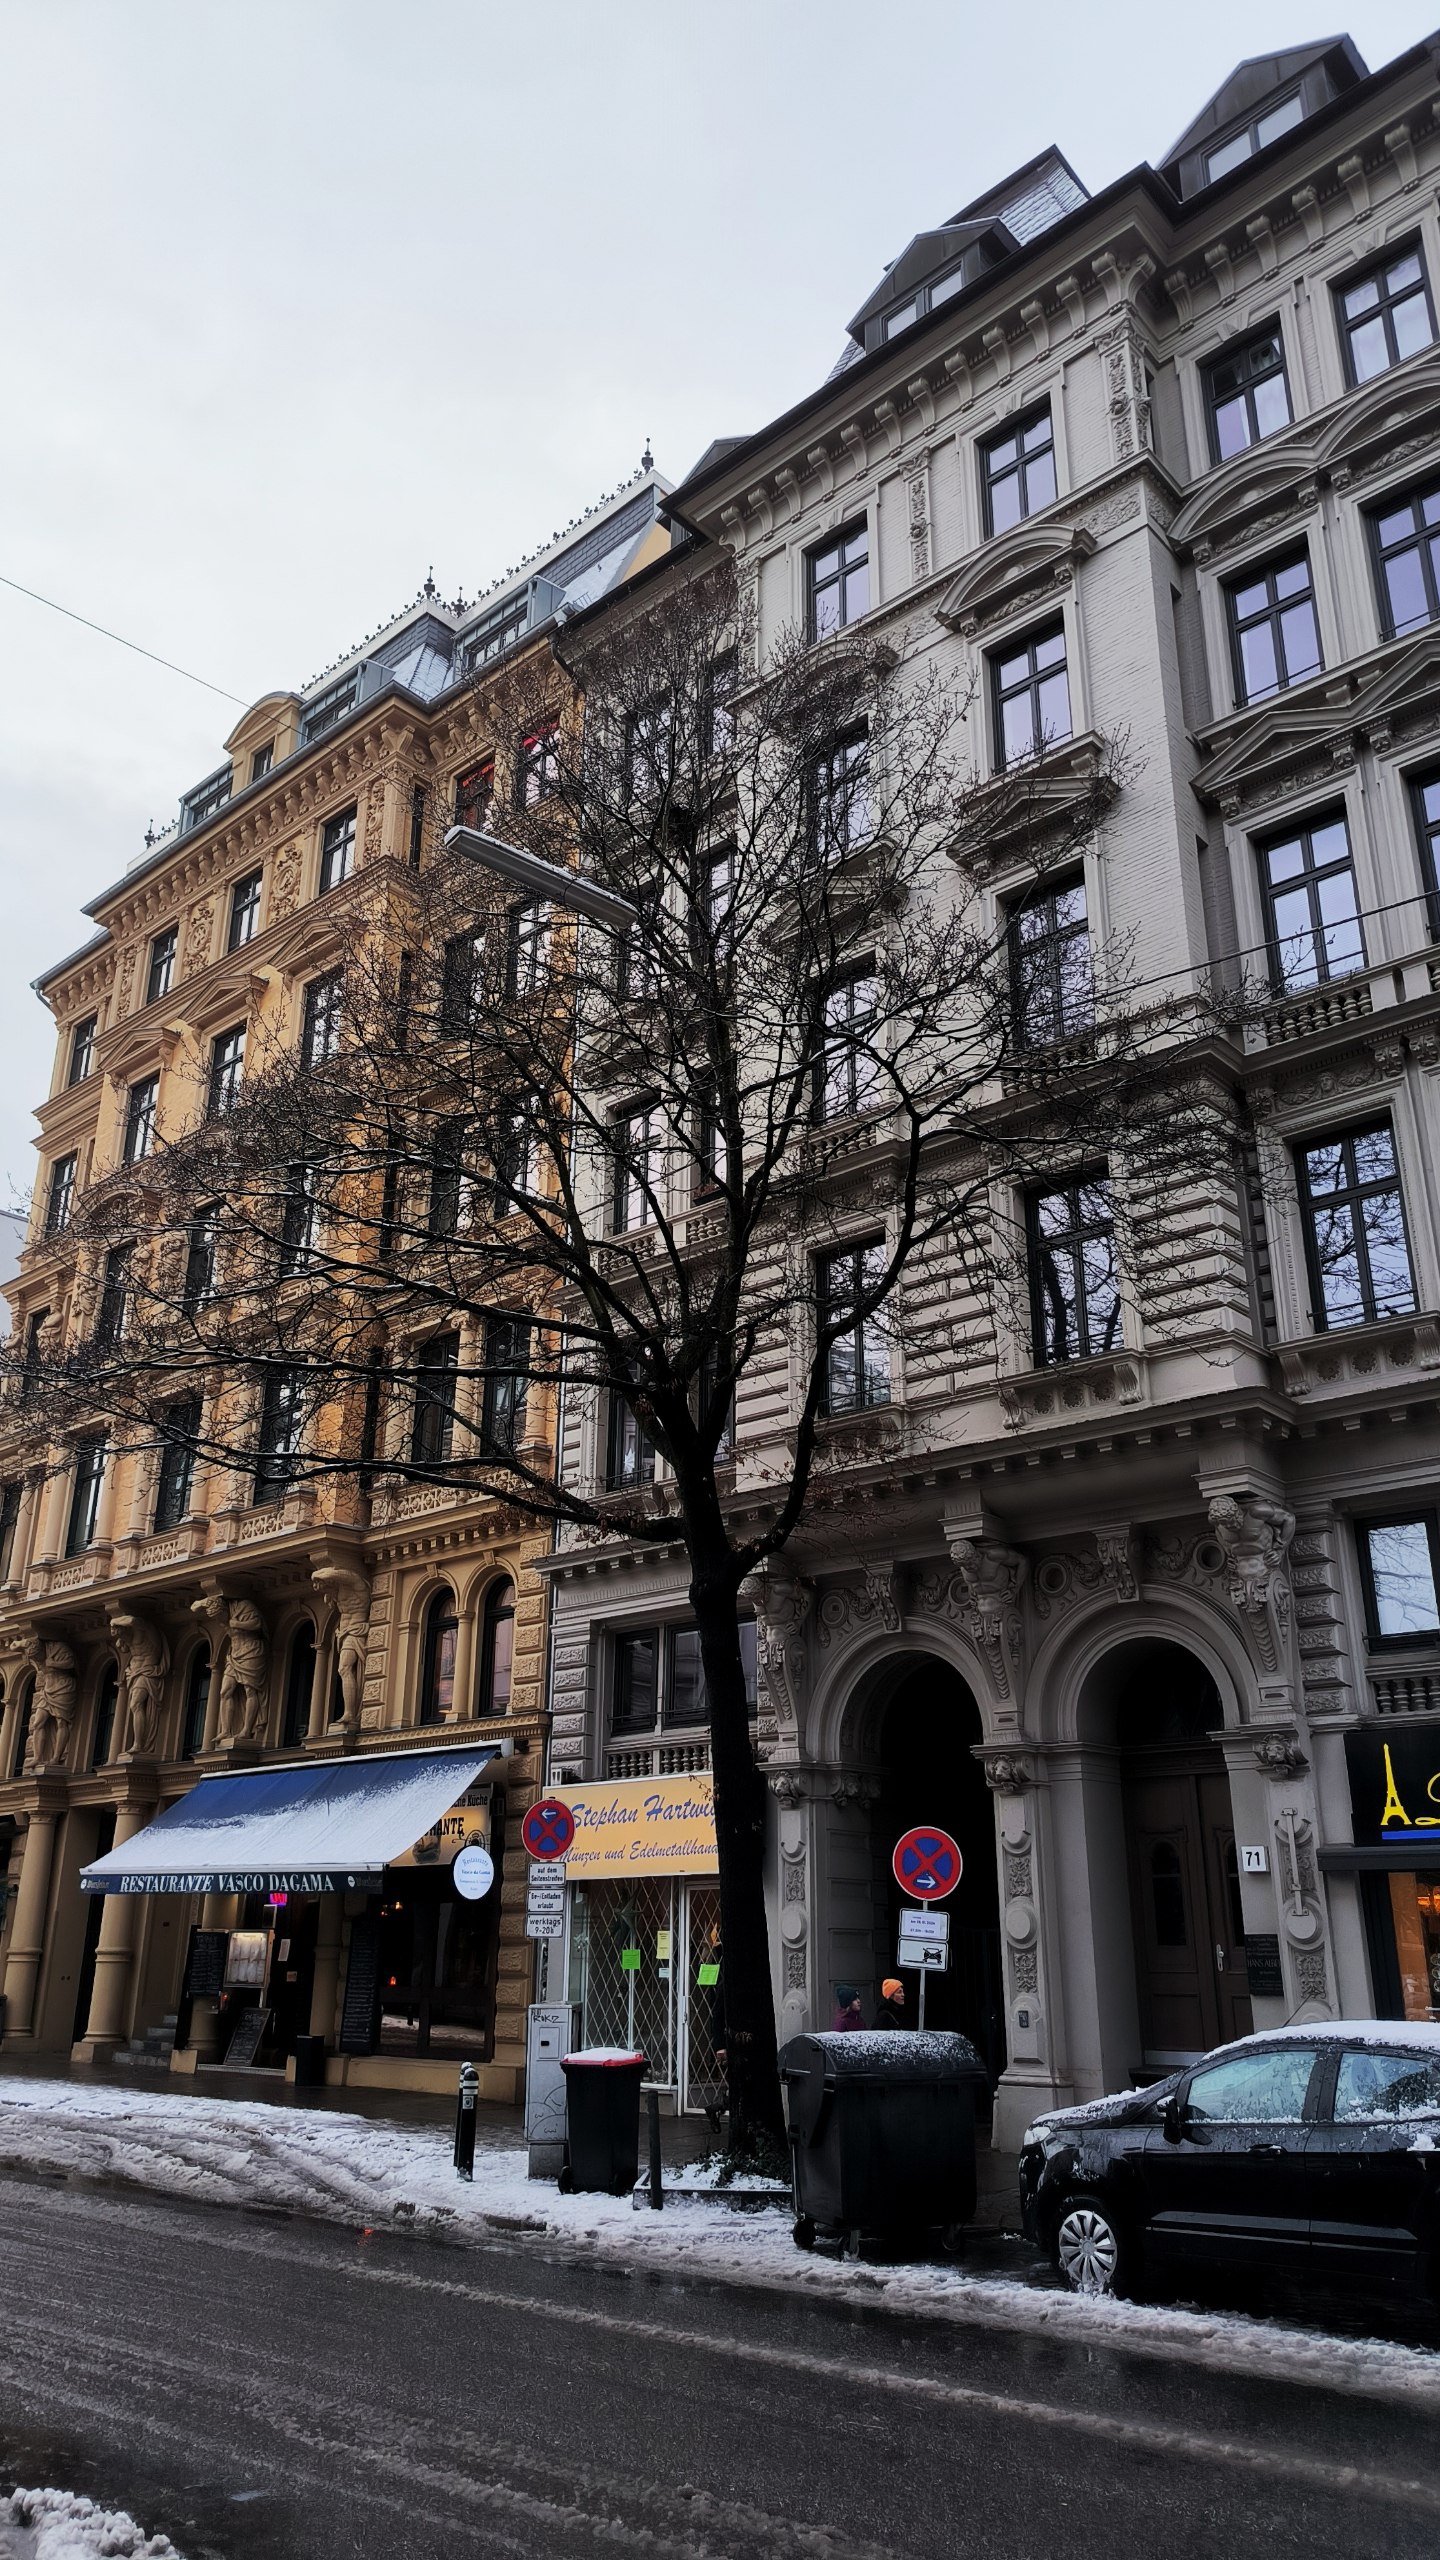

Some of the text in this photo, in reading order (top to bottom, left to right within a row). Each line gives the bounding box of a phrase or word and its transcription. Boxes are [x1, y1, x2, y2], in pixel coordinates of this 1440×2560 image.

[467, 1794, 488, 1807] Küche
[570, 1798, 639, 1832] Stephan
[559, 1846, 601, 1867] Münzen
[604, 1842, 626, 1860] und
[1245, 1851, 1260, 1866] 71
[119, 1874, 214, 1893] RESTAURANTE
[218, 1873, 264, 1892] VASCO
[529, 1917, 561, 1928] werktags
[535, 1926, 554, 1934] 9-20h
